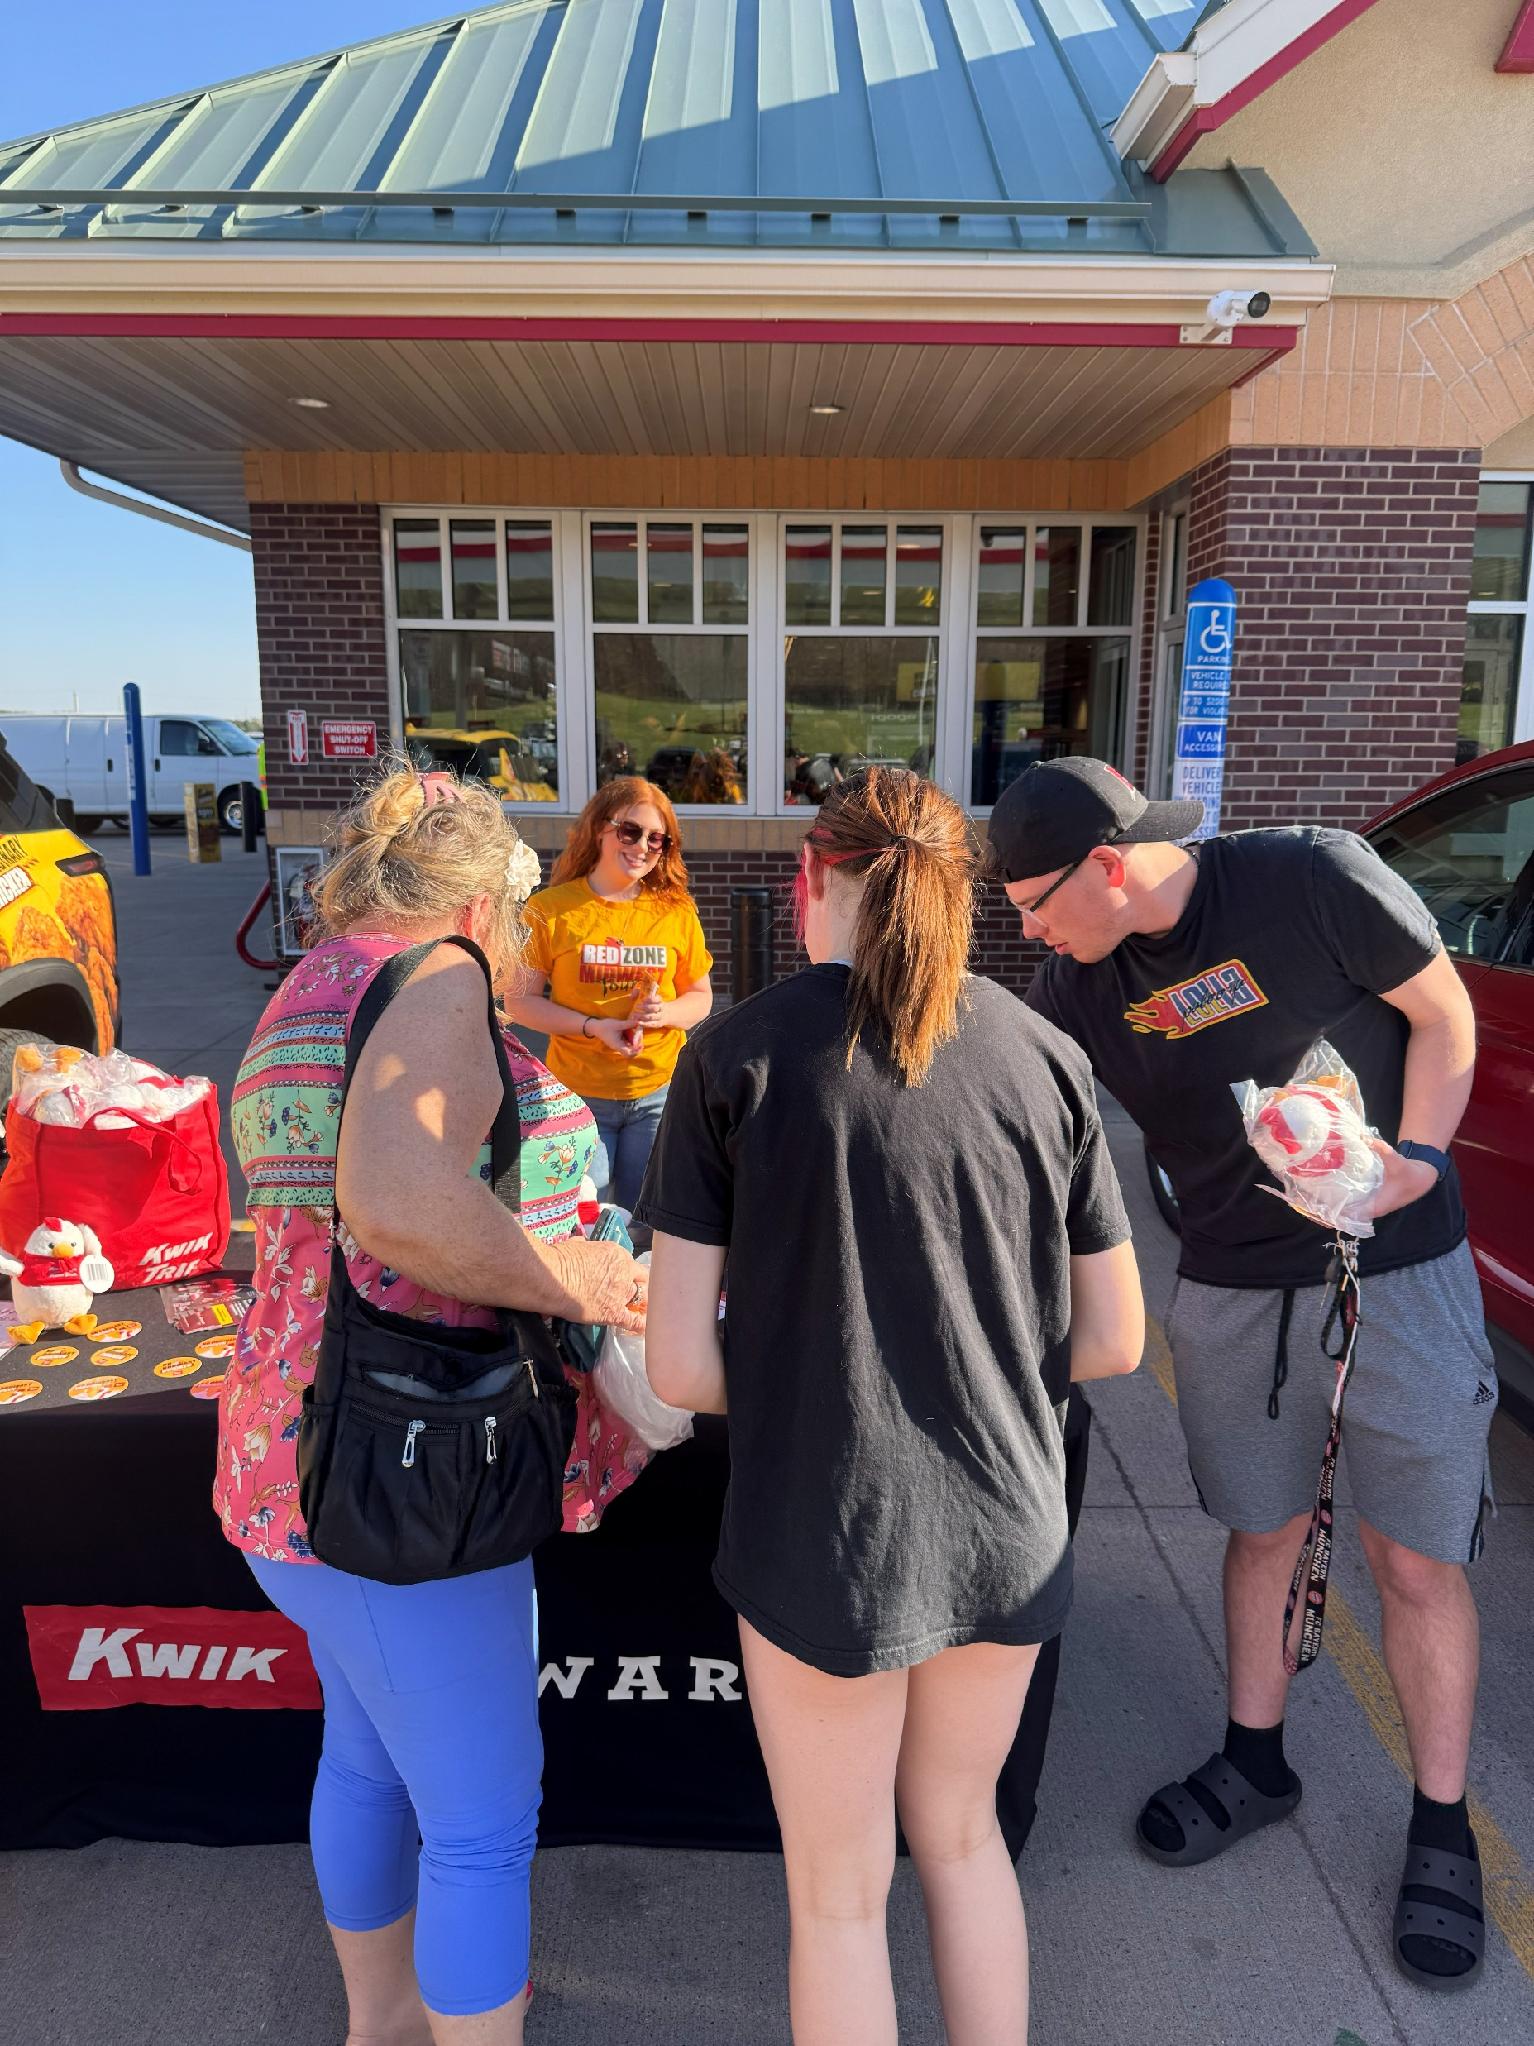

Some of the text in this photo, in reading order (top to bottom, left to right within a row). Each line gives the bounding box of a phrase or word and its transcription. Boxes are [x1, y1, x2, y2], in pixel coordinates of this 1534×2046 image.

[324, 724, 373, 734] EMERGENCY
[329, 735, 369, 744] SHUT-OFF
[1196, 731, 1221, 743] VAN
[334, 746, 366, 755] SWITCH
[582, 944, 666, 966] RED ZONE
[1319, 1549, 1331, 1581] BAYERN
